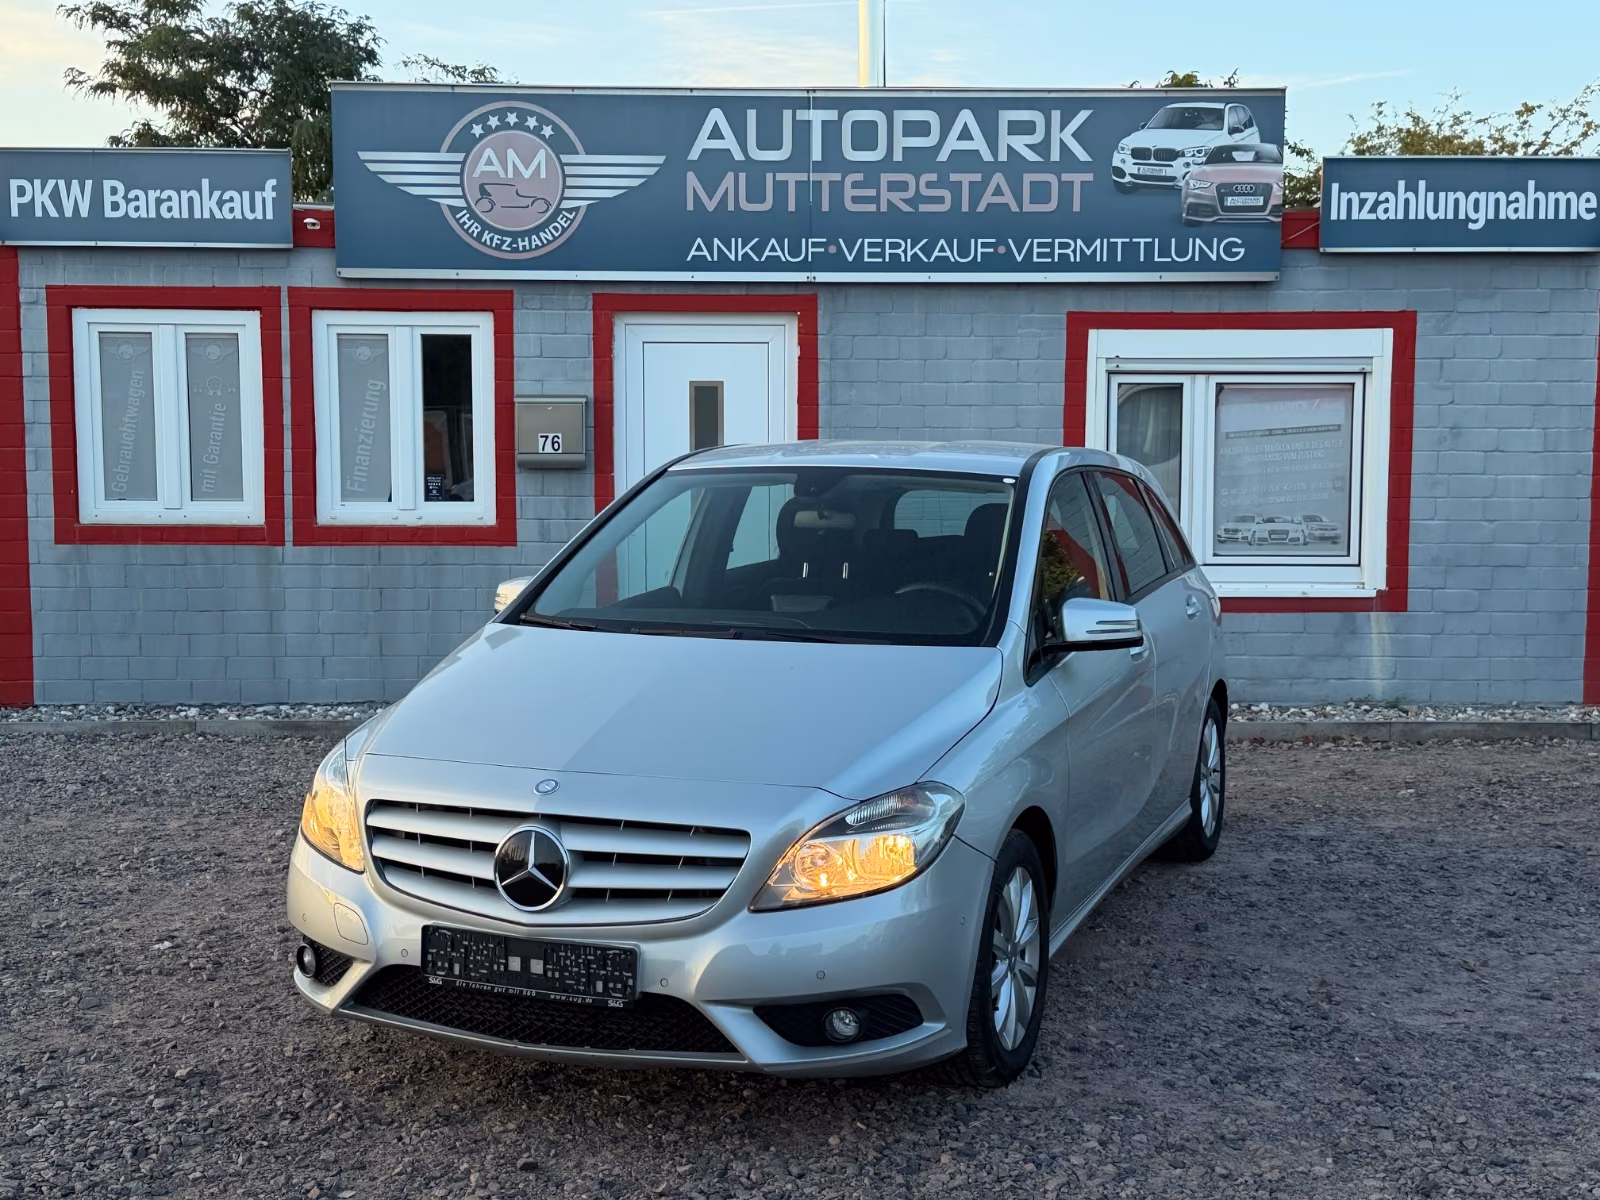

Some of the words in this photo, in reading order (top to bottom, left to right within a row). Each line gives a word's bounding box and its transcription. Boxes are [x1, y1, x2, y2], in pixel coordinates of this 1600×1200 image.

[687, 107, 1094, 162] AUTOPARK
[471, 147, 547, 179] AM
[9, 178, 93, 218] PKW
[102, 178, 277, 220] Barankauf
[686, 171, 1094, 213] MUTTERSTADT
[1330, 179, 1598, 230] Inzahlungnahme
[455, 209, 480, 238] IHR
[481, 208, 577, 252] KFZ-HANDEL
[686, 237, 827, 263] ANKAUF
[839, 237, 997, 263] VERKAUF
[1007, 237, 1246, 263] VERMITTLUNG
[111, 369, 145, 493] Gebrauchtwagen
[203, 402, 226, 466] Garantie
[346, 379, 387, 493] Finanzierung
[539, 434, 561, 452] 76
[200, 472, 217, 493] mit
